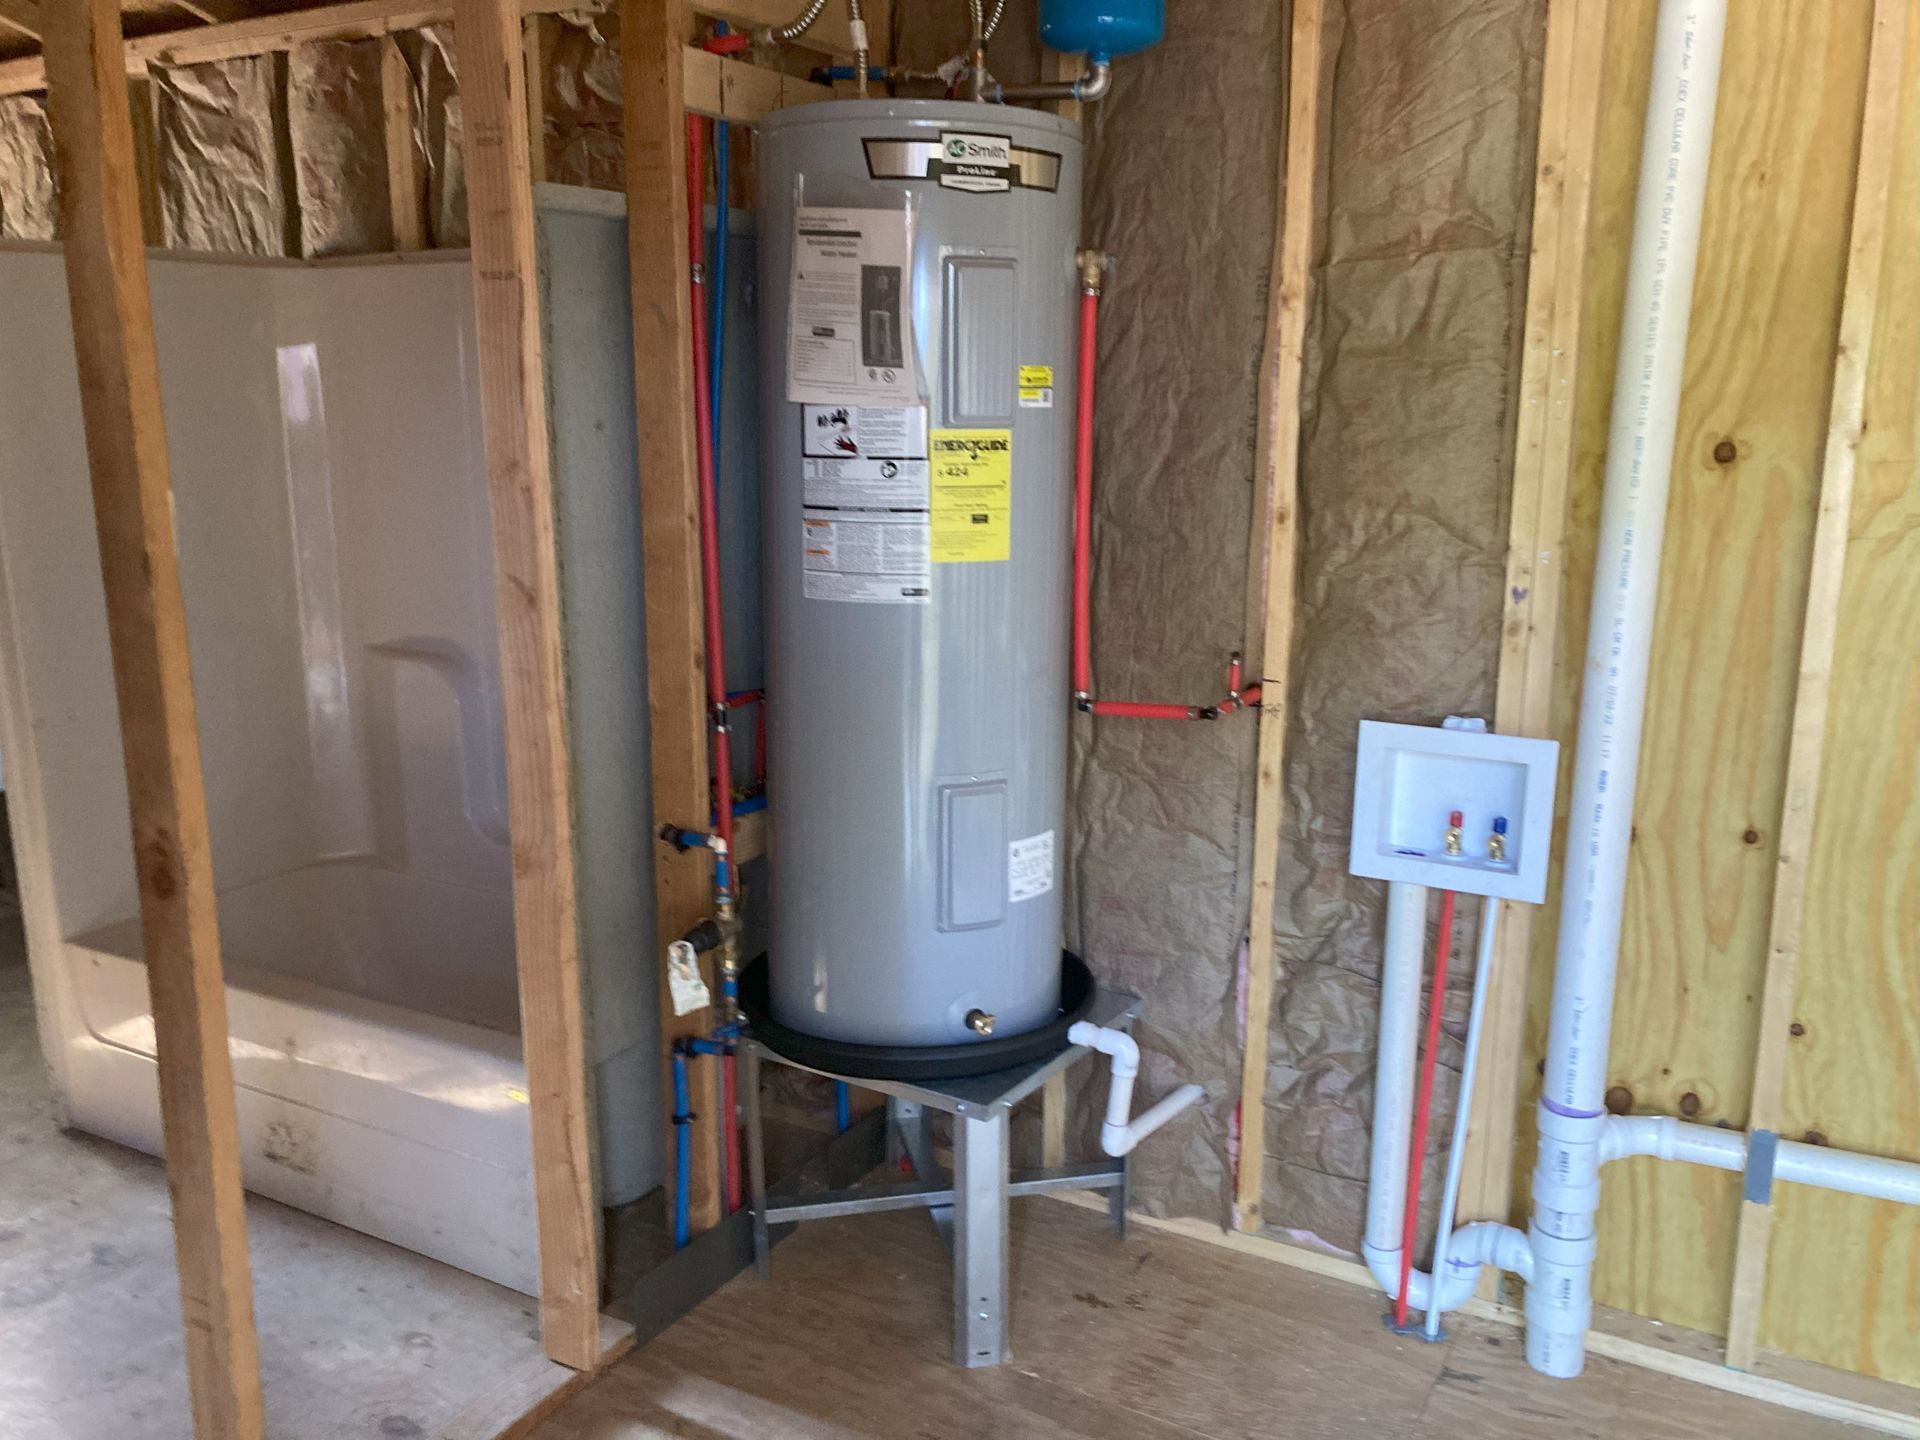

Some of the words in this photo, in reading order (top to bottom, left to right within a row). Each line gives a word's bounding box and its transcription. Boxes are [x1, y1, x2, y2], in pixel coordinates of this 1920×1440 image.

[1670, 106, 1686, 152] CELLULAR
[968, 143, 1006, 160] Smith
[1664, 184, 1675, 202] PVC
[1661, 206, 1673, 224] DWV
[1645, 315, 1659, 348] SERIES
[934, 440, 1008, 451] ENERGYGUIDE
[945, 468, 968, 478] 424
